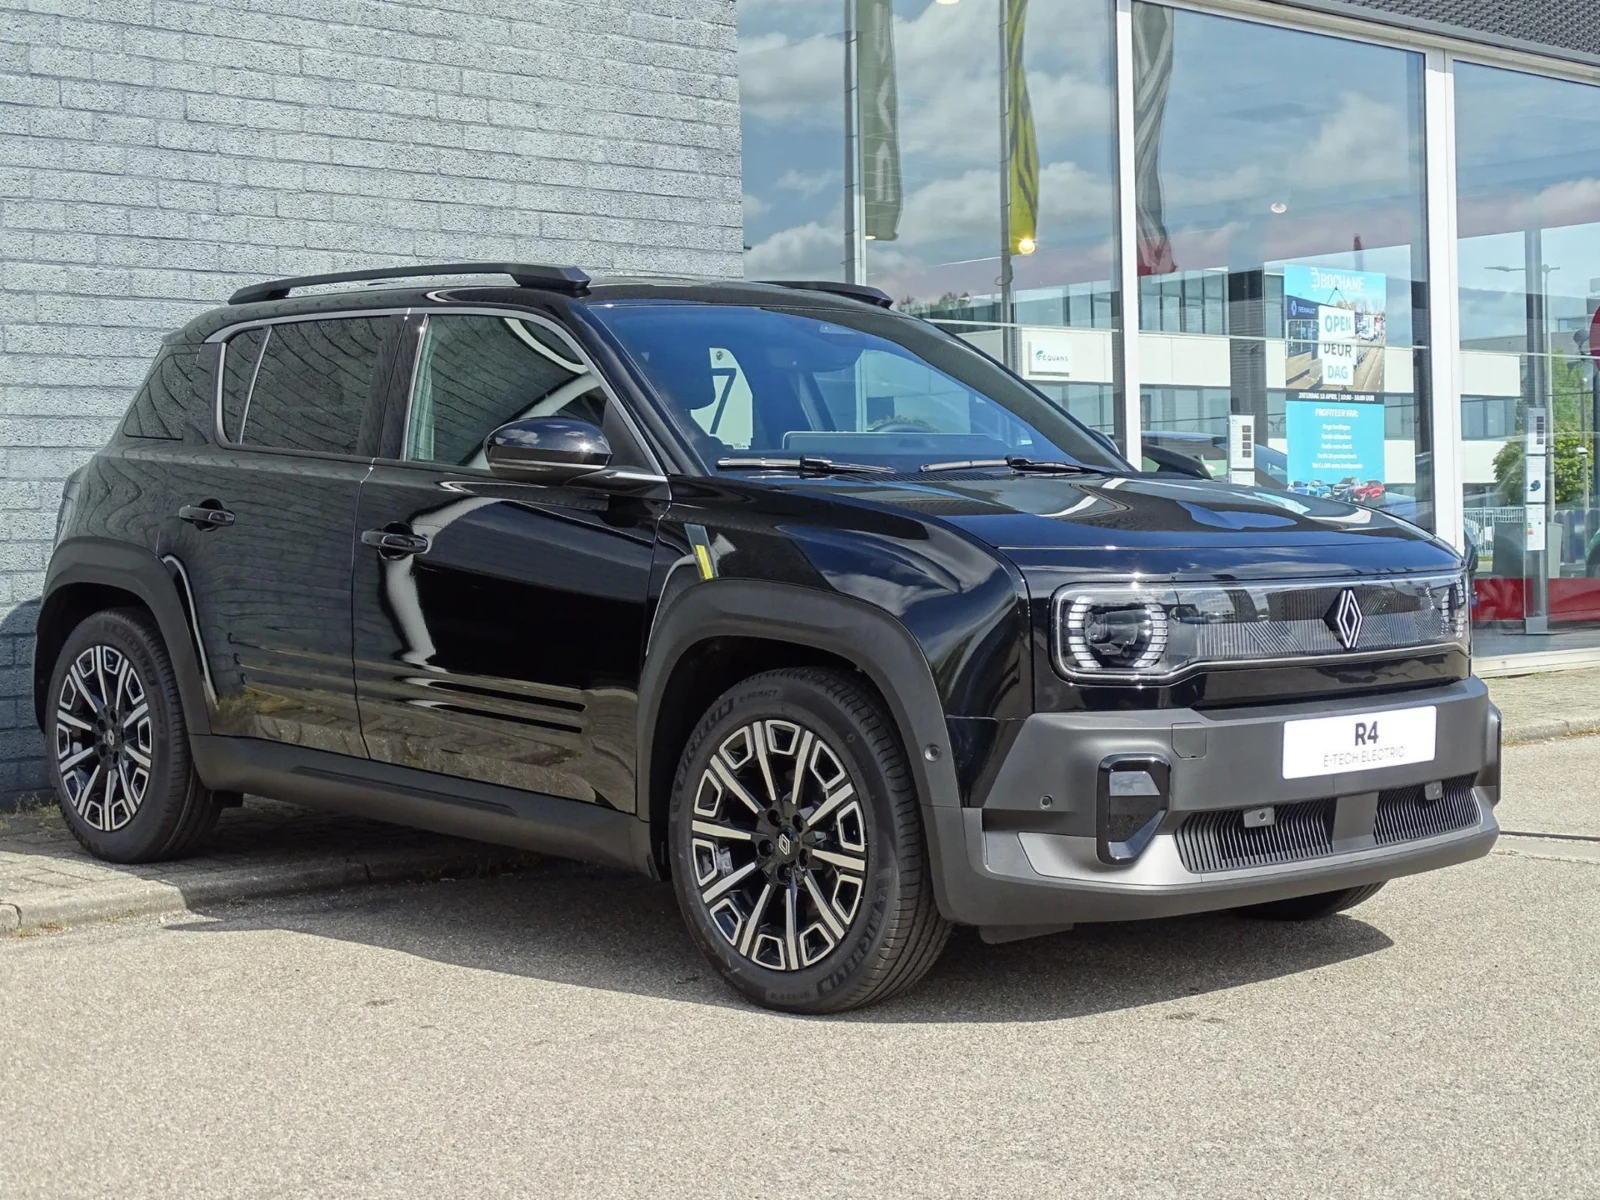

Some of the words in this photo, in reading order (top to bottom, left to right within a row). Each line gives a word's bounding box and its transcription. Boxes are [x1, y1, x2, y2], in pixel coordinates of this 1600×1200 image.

[1321, 273, 1366, 291] BOCHANE
[1324, 314, 1351, 333] OPEN
[1042, 354, 1069, 362] EQUANS
[1323, 343, 1352, 358] DEUR
[1327, 365, 1349, 380] DAG
[1355, 720, 1379, 747] R4
[1323, 751, 1359, 767] E-TECH
[1361, 745, 1405, 763] ELECTRIC
[816, 904, 884, 997] MICHELIN
